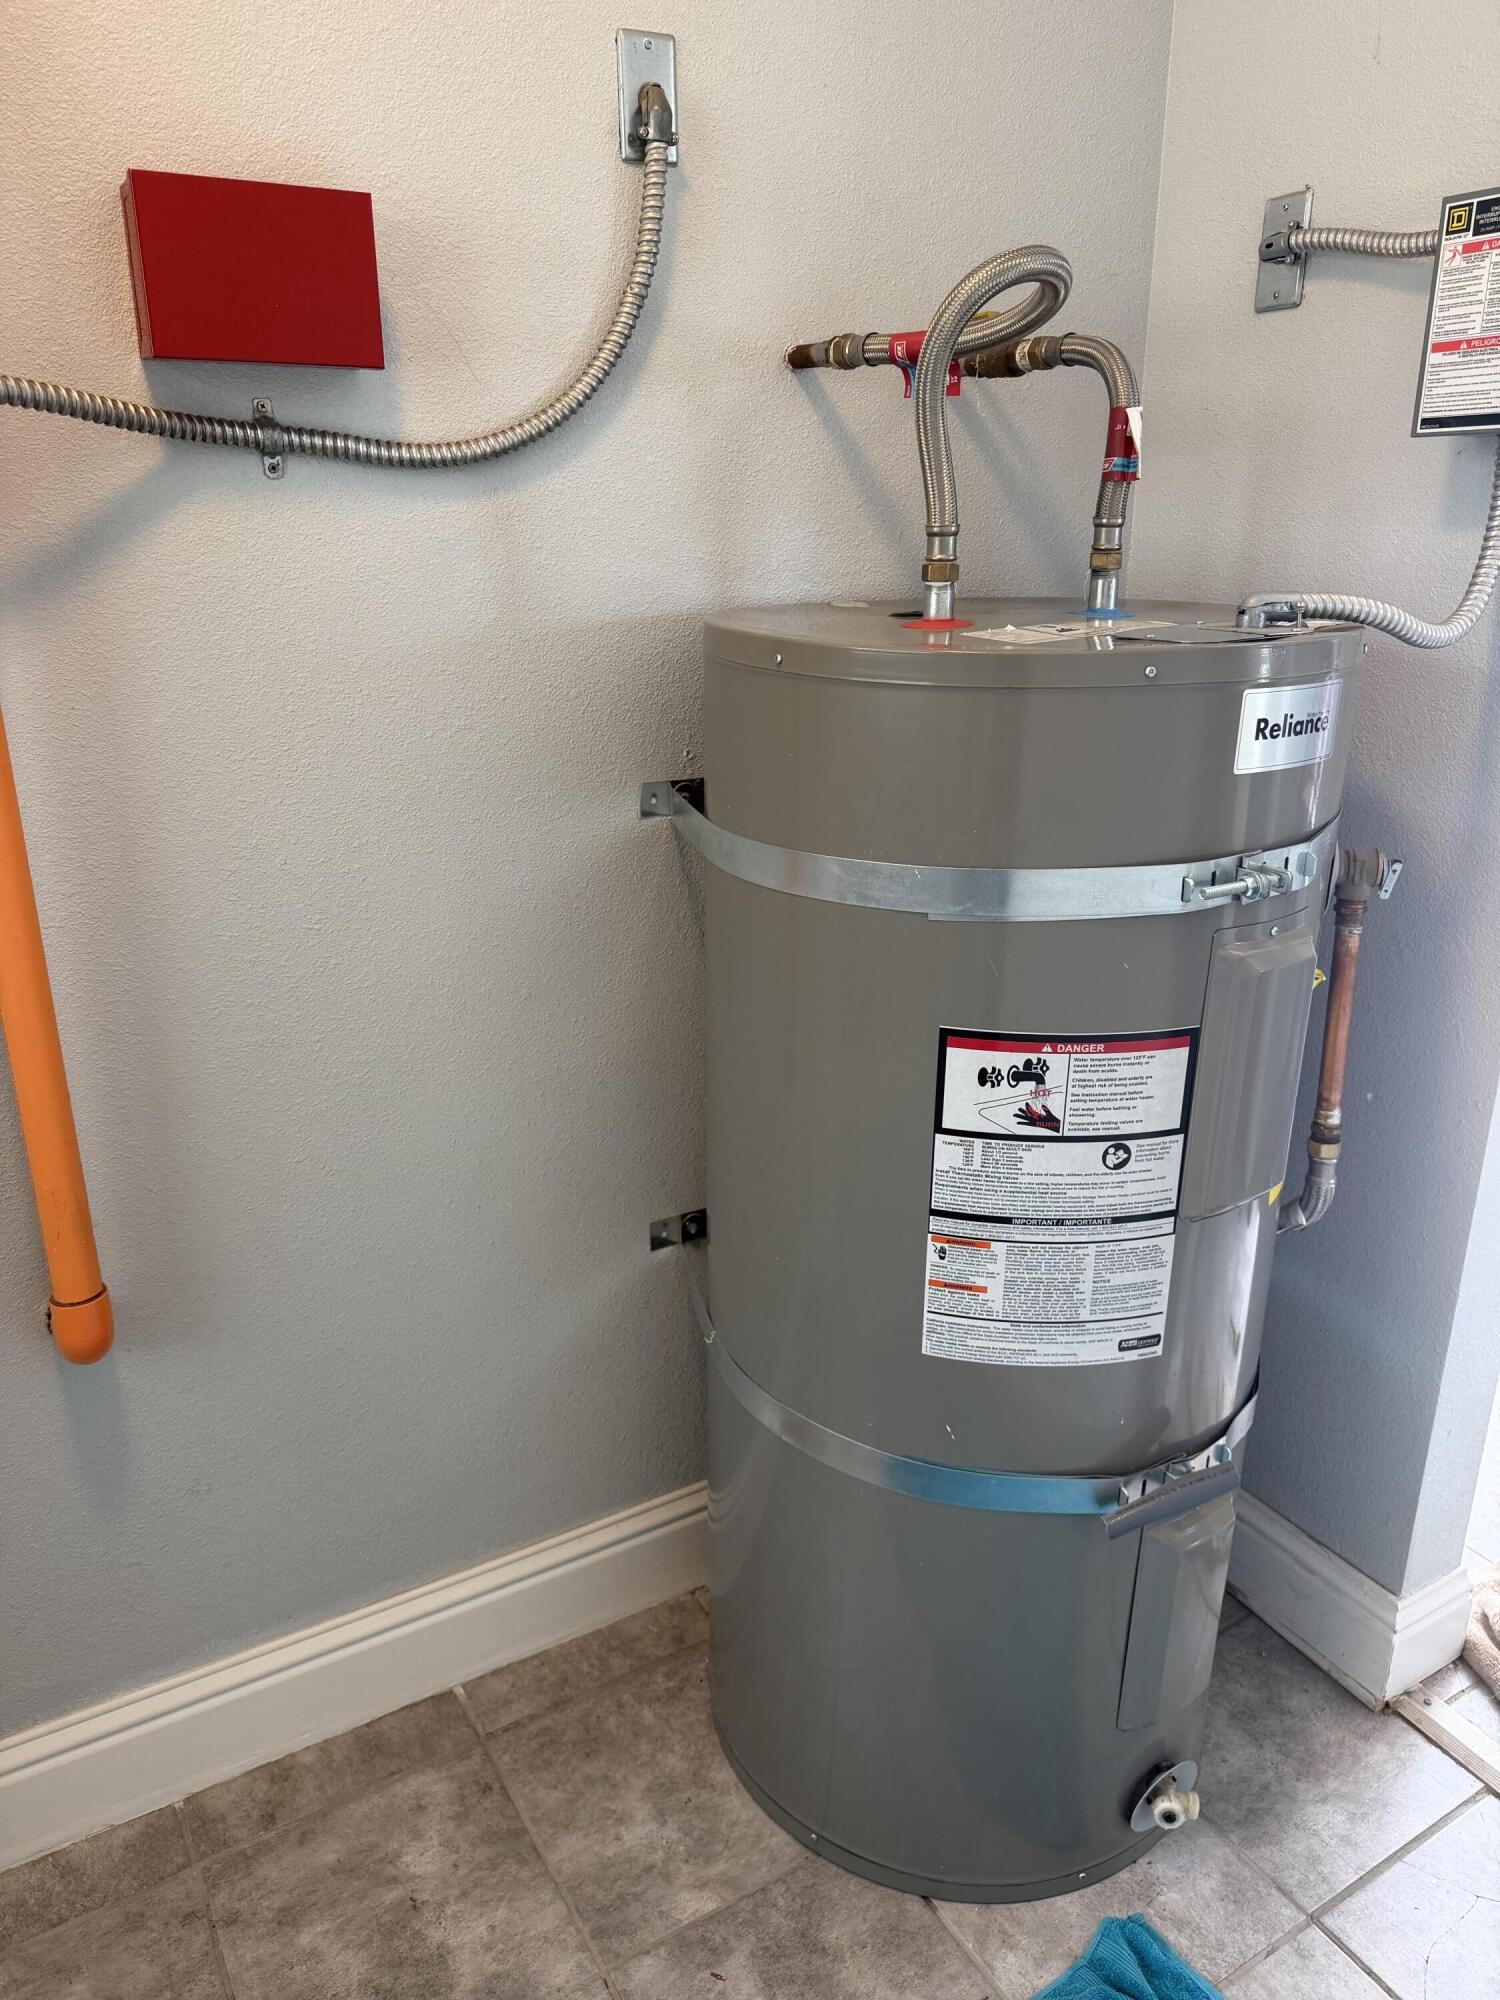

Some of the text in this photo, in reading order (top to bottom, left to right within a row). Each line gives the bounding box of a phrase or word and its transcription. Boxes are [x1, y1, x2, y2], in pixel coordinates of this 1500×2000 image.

[1255, 713, 1329, 741] Reliance
[1057, 1044, 1104, 1053] DANGER
[1030, 1089, 1052, 1097] HOT
[1012, 1218, 1057, 1226] IMPORTANT
[1063, 1218, 1112, 1226] IMPORTANTE
